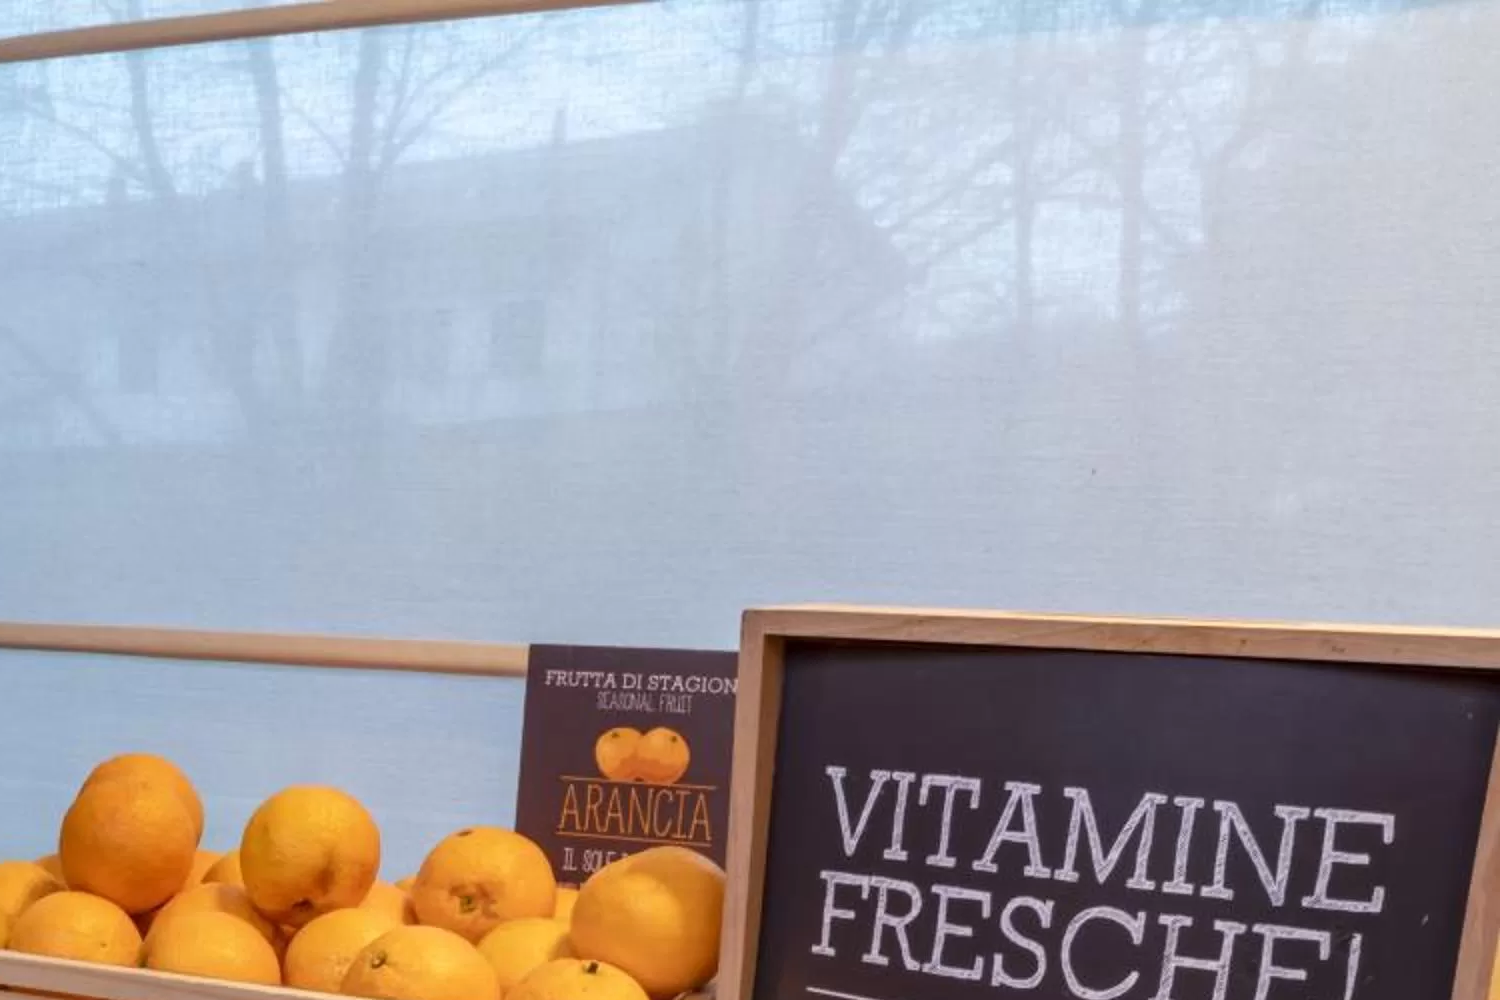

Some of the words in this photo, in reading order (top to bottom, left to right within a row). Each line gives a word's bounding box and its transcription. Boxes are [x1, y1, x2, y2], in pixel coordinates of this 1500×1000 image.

[545, 669, 617, 689] FRUTTA
[622, 672, 643, 690] DI
[647, 675, 739, 694] STAGION
[557, 783, 712, 841] ARANCIA
[824, 766, 1394, 914] VITAMINE
